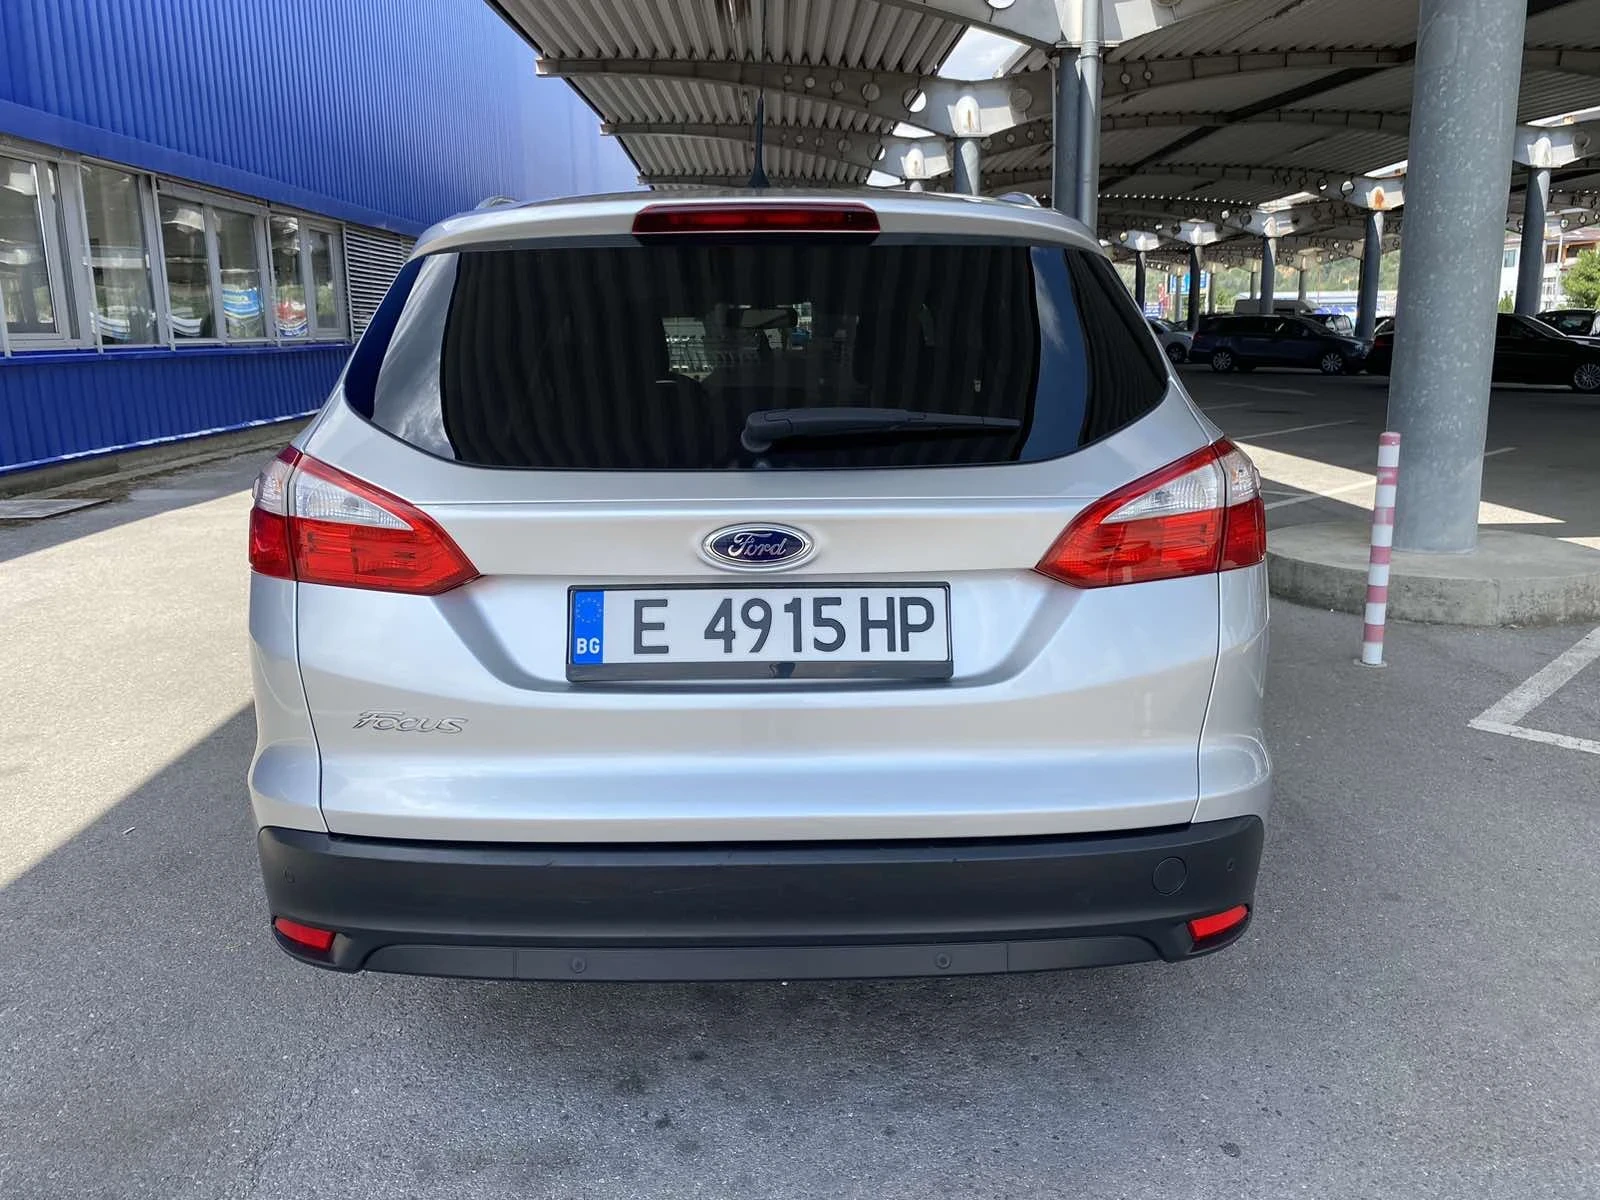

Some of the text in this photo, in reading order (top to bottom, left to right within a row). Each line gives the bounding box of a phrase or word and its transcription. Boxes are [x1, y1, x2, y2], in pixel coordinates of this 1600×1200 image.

[728, 532, 788, 557] Ford
[633, 599, 669, 655] E
[576, 637, 600, 655] BG
